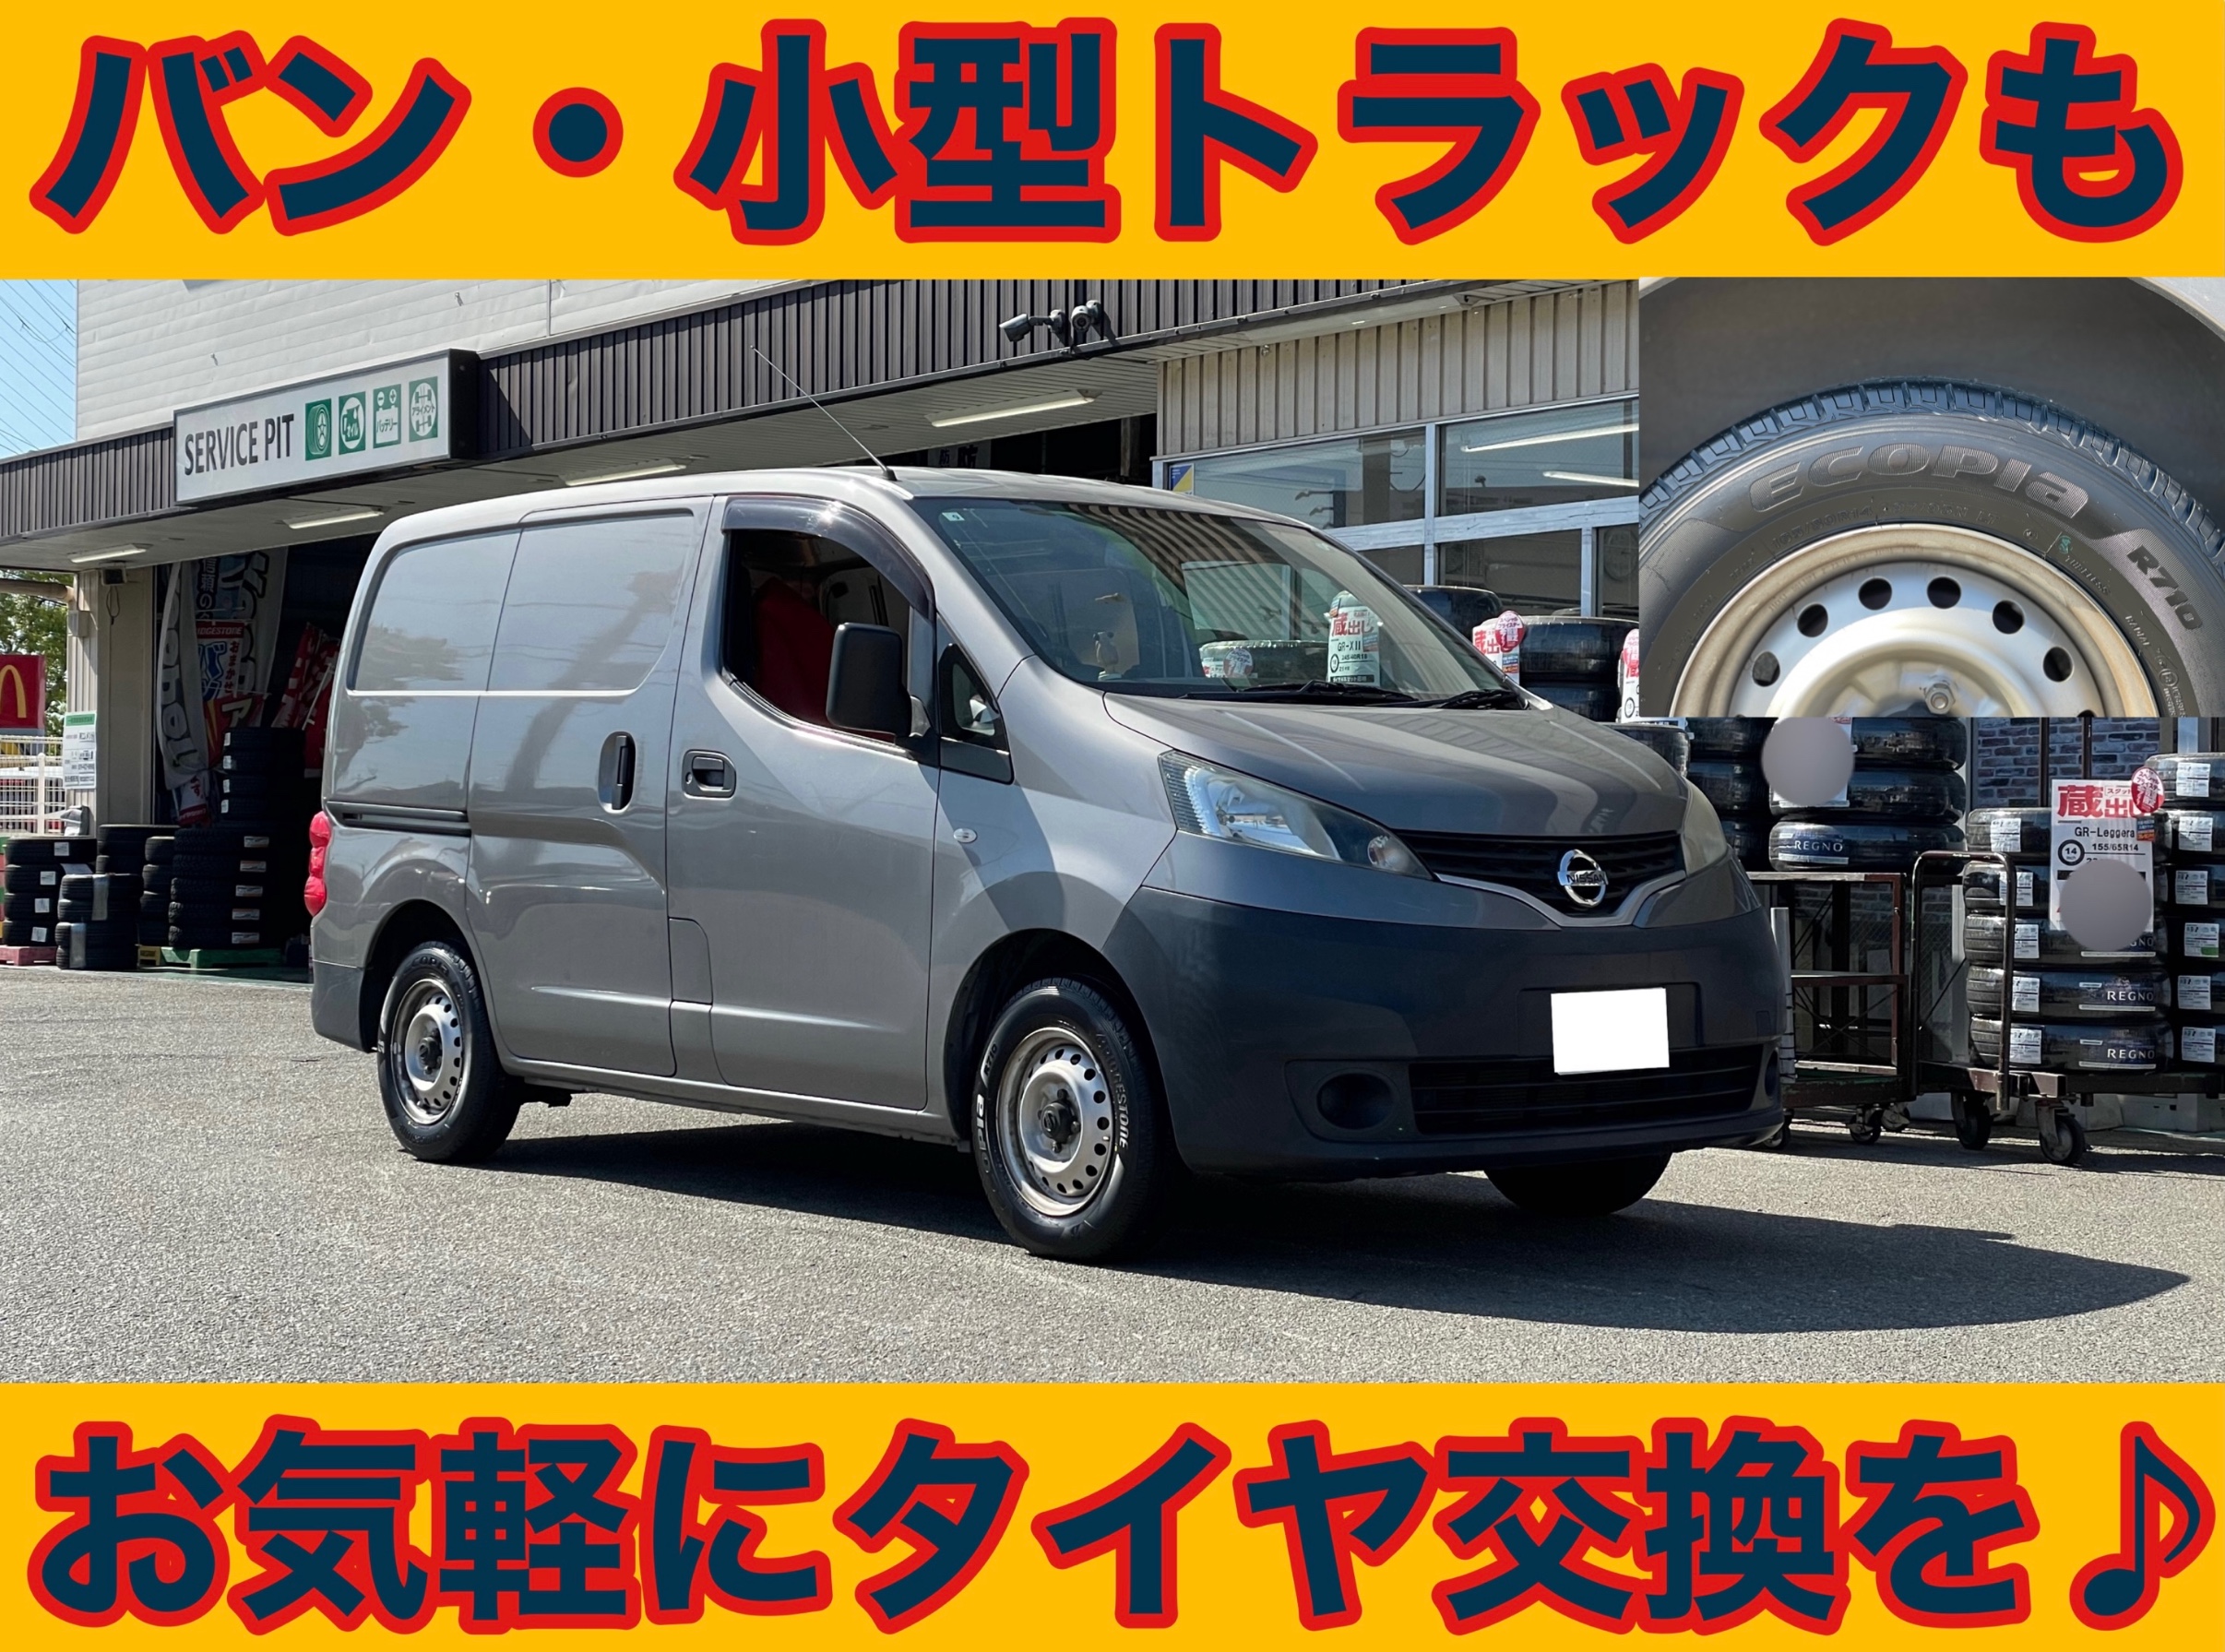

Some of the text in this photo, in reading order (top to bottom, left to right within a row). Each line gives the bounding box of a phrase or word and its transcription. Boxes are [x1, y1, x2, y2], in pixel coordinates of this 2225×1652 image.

[411, 403, 436, 416] アライメント
[375, 417, 399, 434] バッテリー
[184, 413, 294, 476] SERVICE PIT
[1750, 443, 2089, 519] ECOPIA
[2127, 545, 2203, 630] R710
[196, 626, 243, 636] IDGESTONE
[2075, 826, 2135, 838] GR-Leggera
[1794, 840, 1843, 852] REGNO
[2064, 847, 2077, 855] 14
[2092, 843, 2139, 851] 155/65R14
[1566, 874, 1605, 884] NISSAN
[2107, 990, 2154, 1002] REGNO
[2107, 1048, 2155, 1059] REGNO
